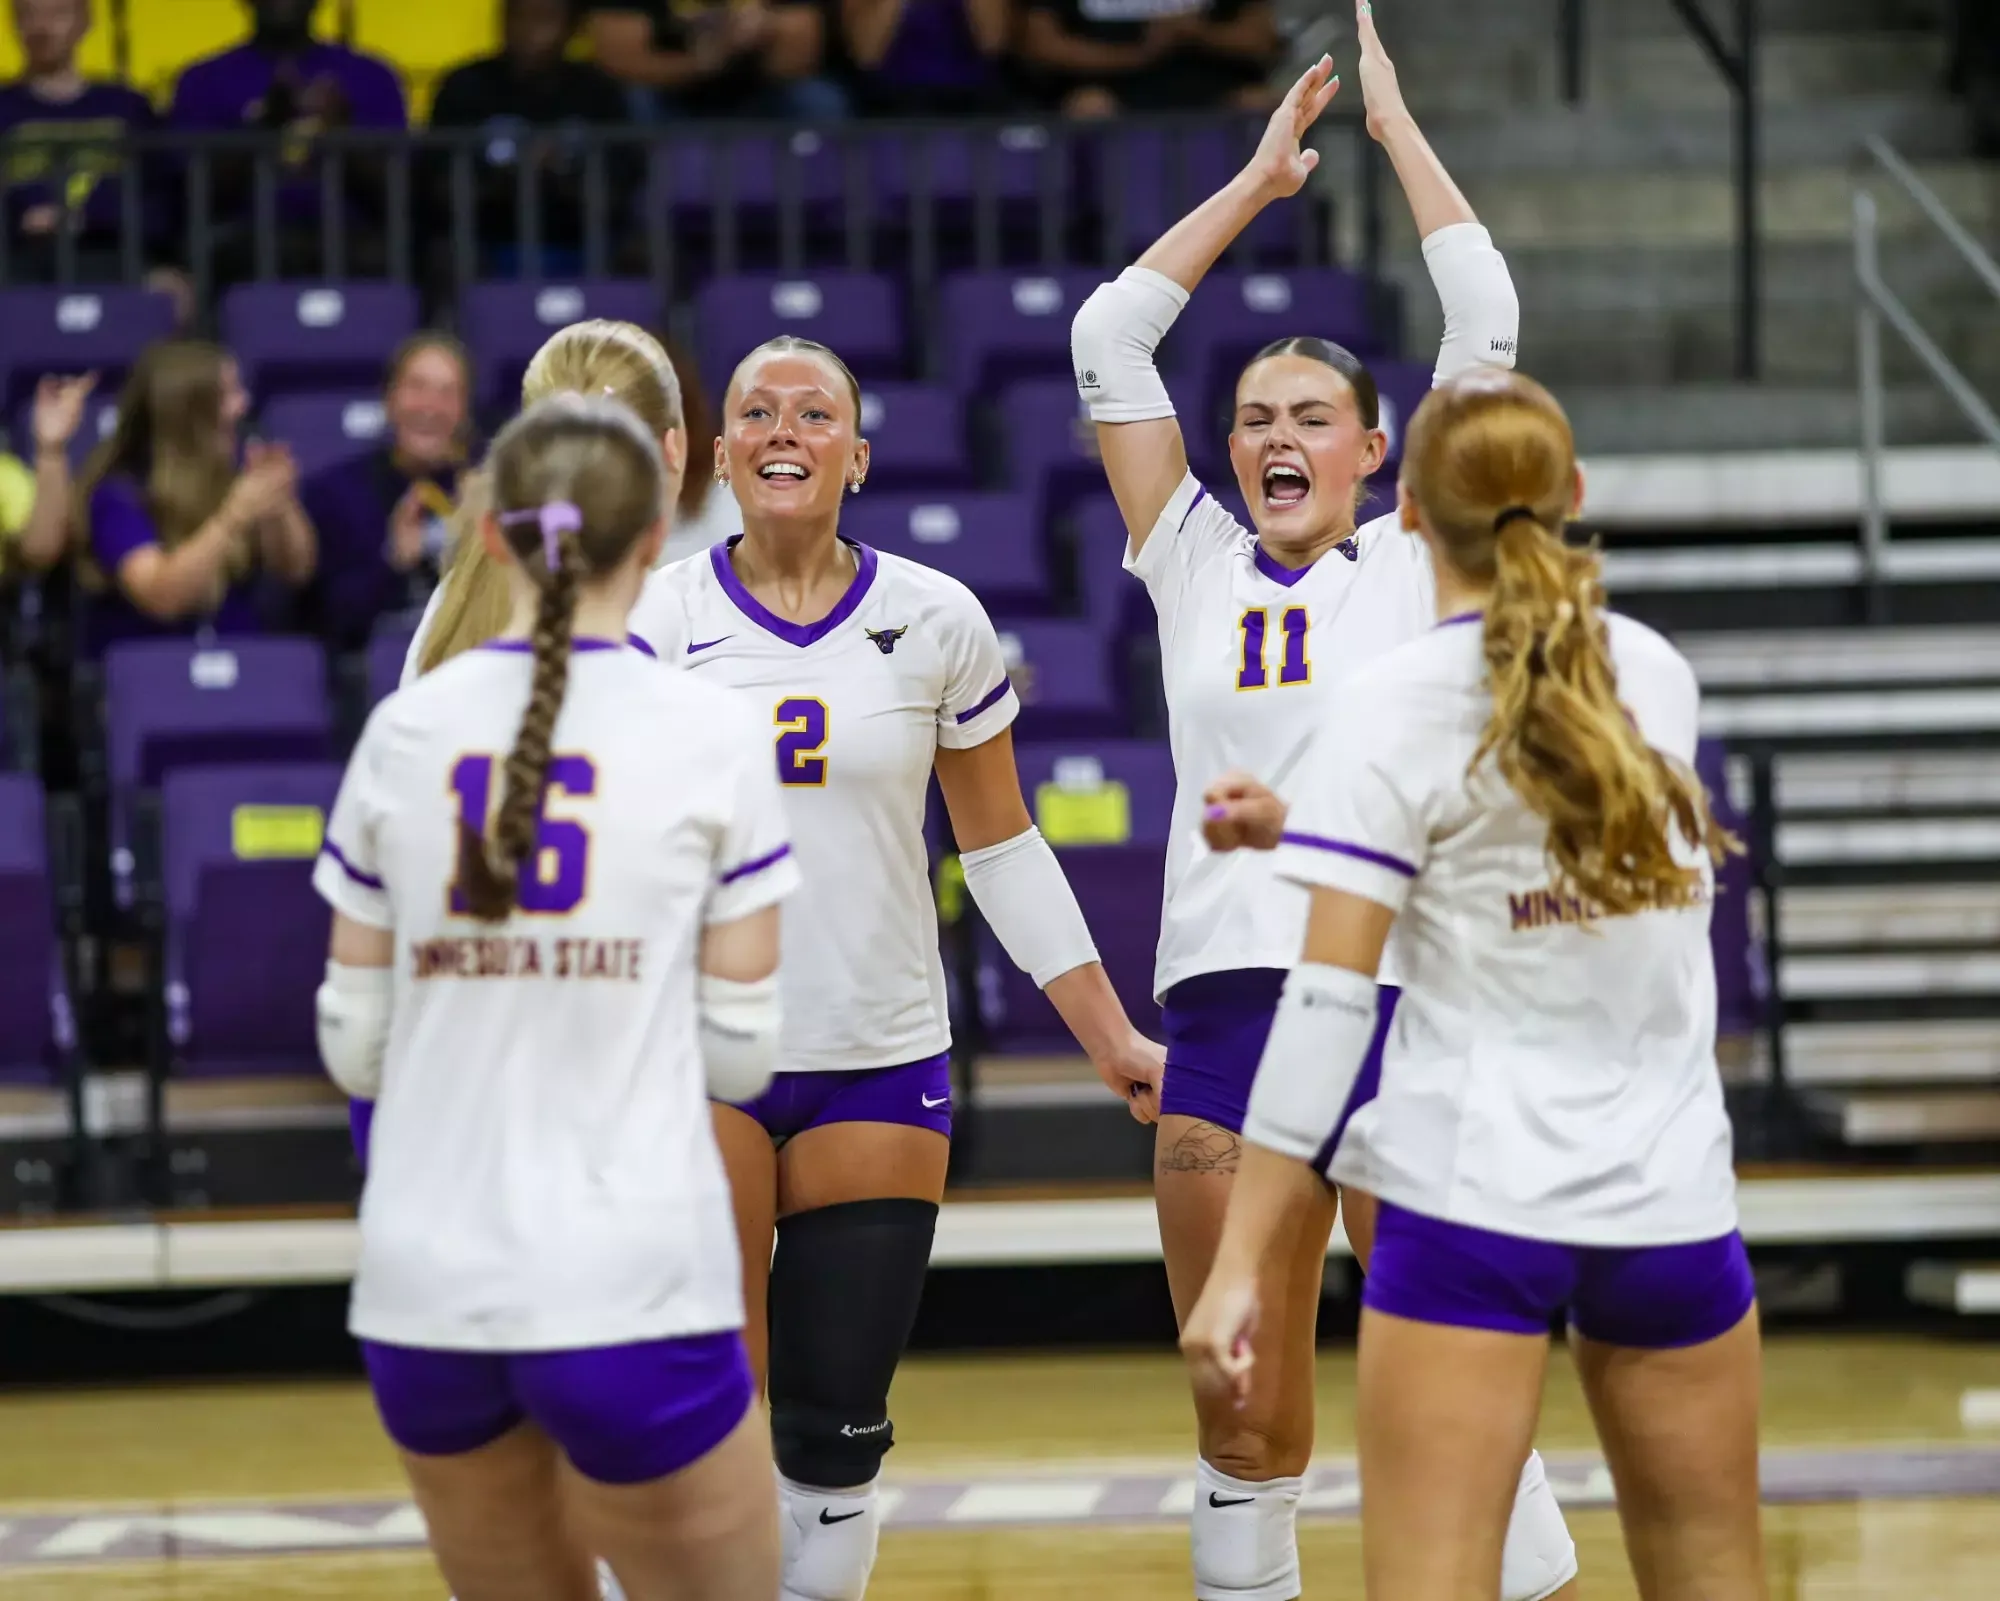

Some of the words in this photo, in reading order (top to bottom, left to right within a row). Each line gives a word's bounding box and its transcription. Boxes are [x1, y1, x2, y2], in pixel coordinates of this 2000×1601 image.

[1236, 605, 1311, 691] 11
[773, 695, 829, 787] 2
[447, 753, 596, 917] 16
[553, 937, 643, 980] STATE
